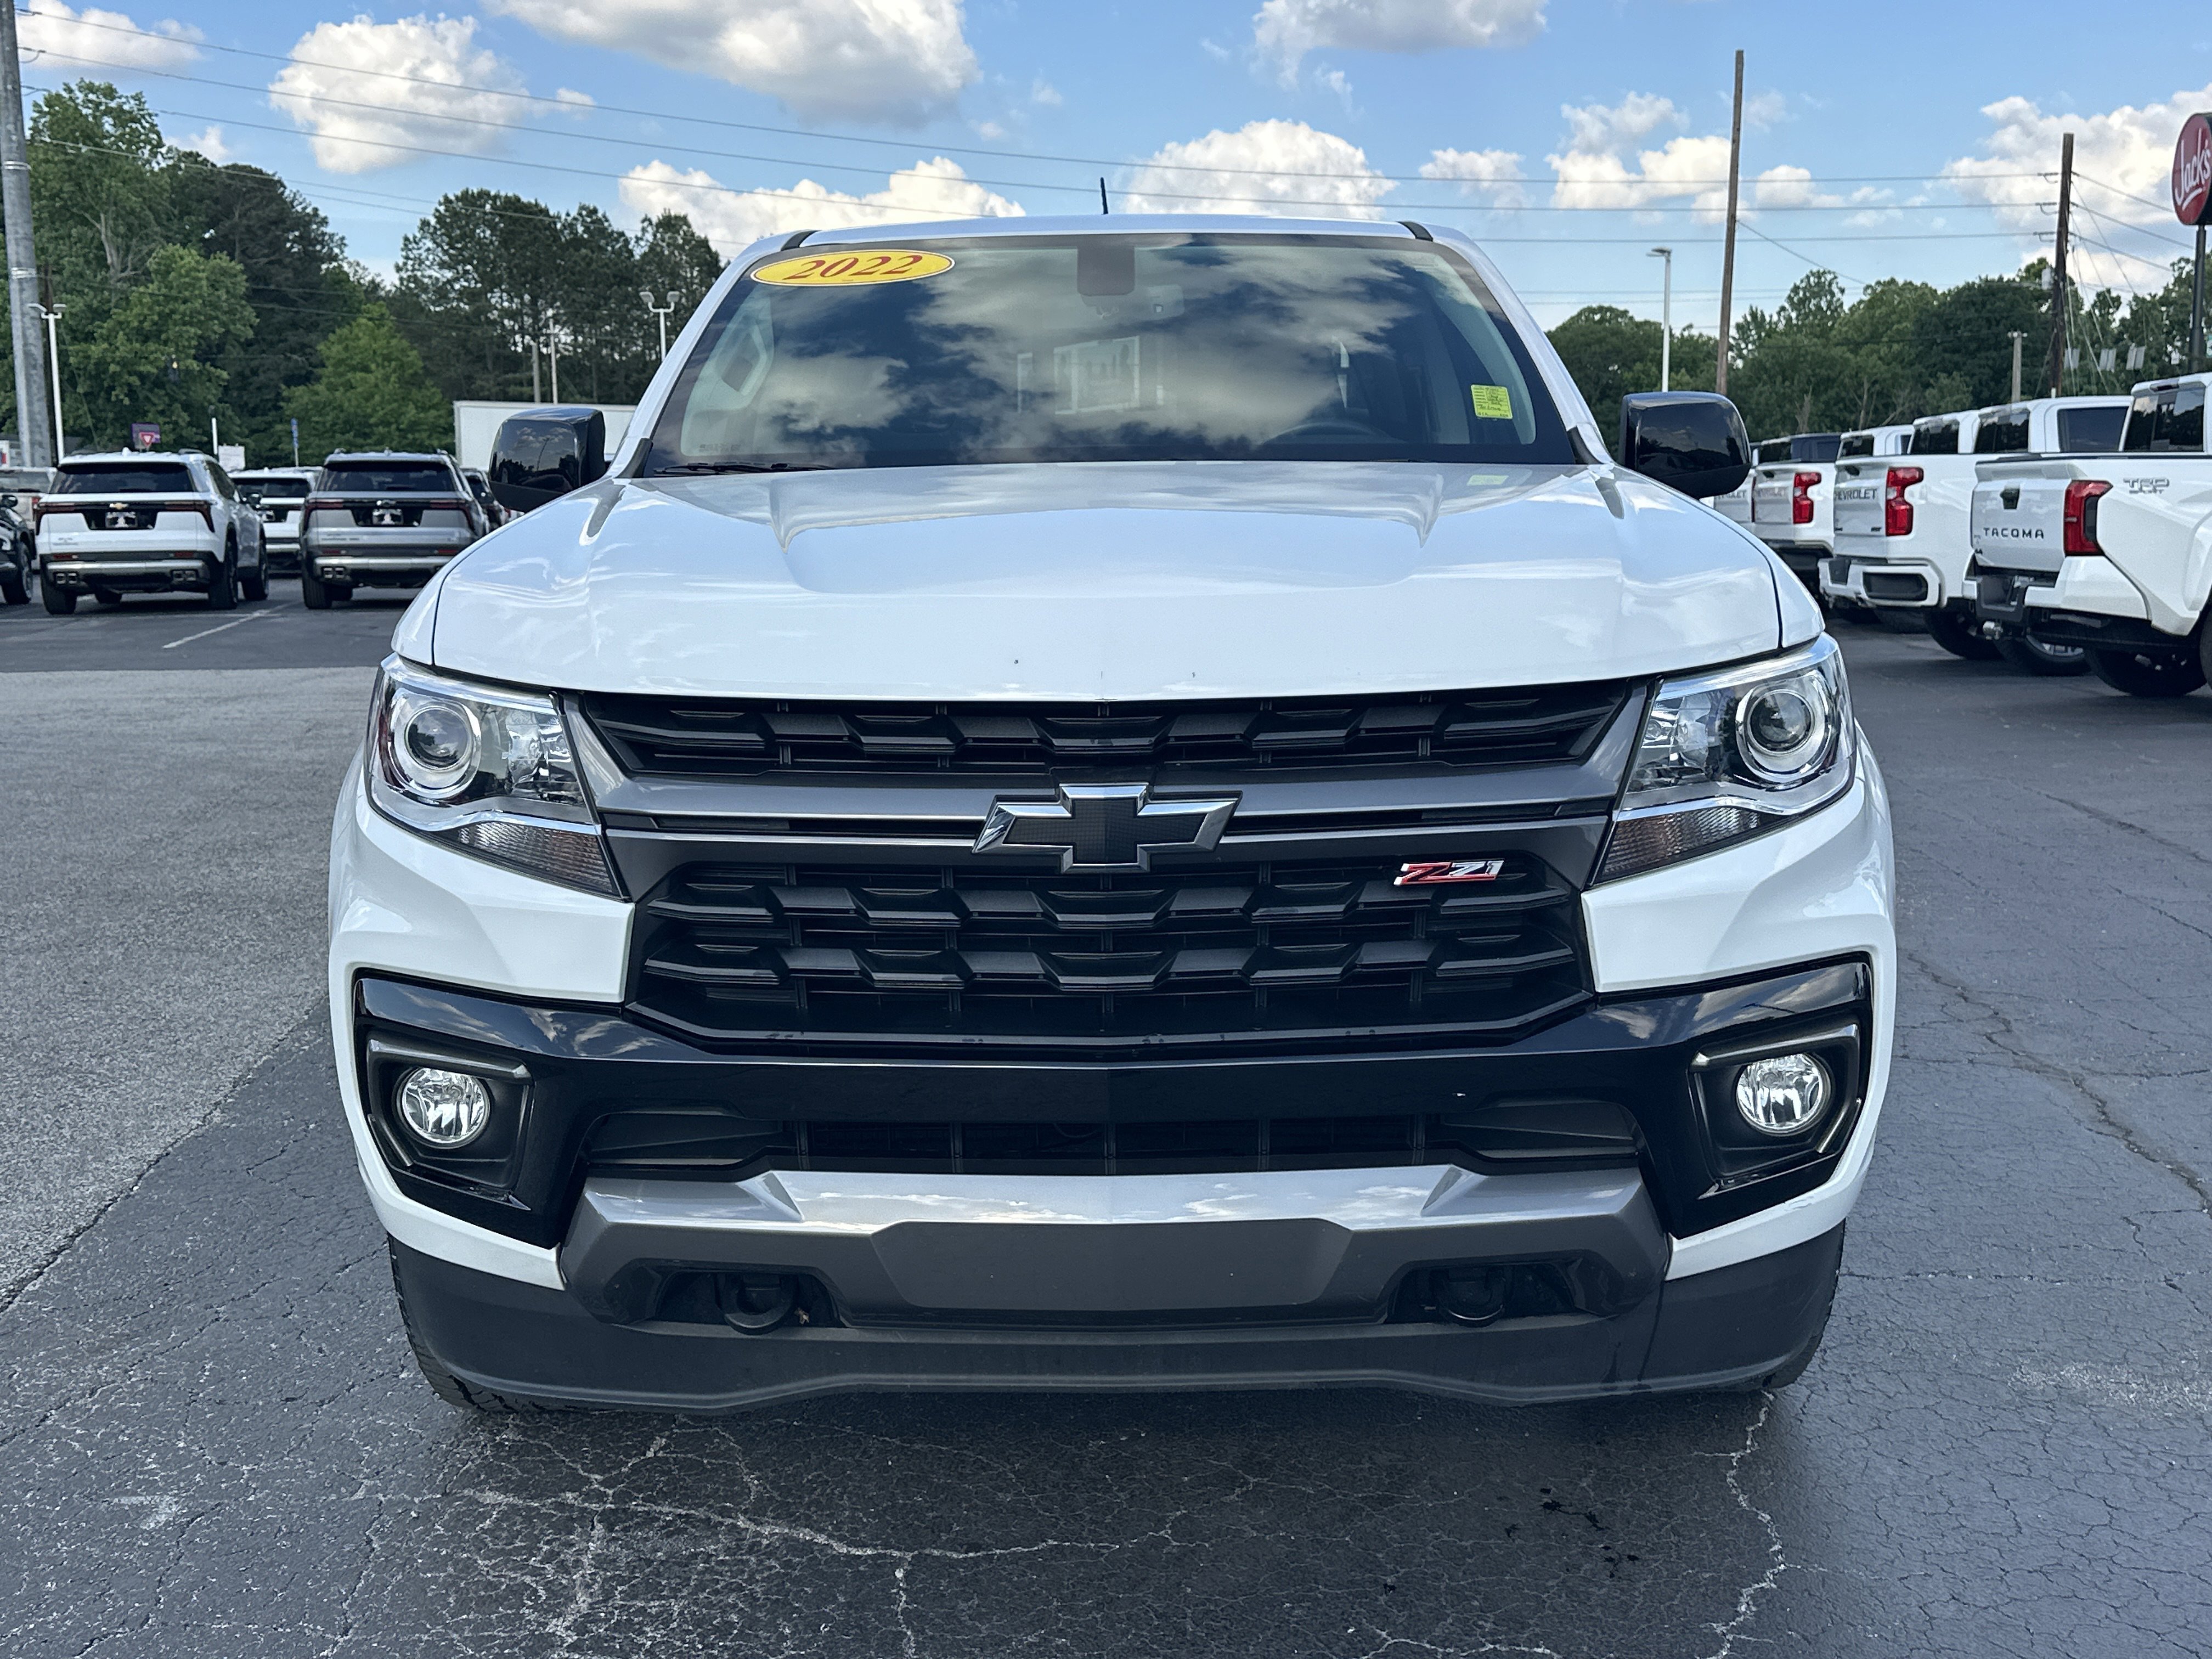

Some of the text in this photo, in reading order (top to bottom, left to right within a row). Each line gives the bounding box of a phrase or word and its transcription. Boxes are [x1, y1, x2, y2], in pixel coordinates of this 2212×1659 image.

[2175, 128, 2210, 205] Jack's
[783, 255, 923, 280] 2022
[1983, 527, 2044, 539] TACOMA
[1393, 860, 1504, 885] Z71
